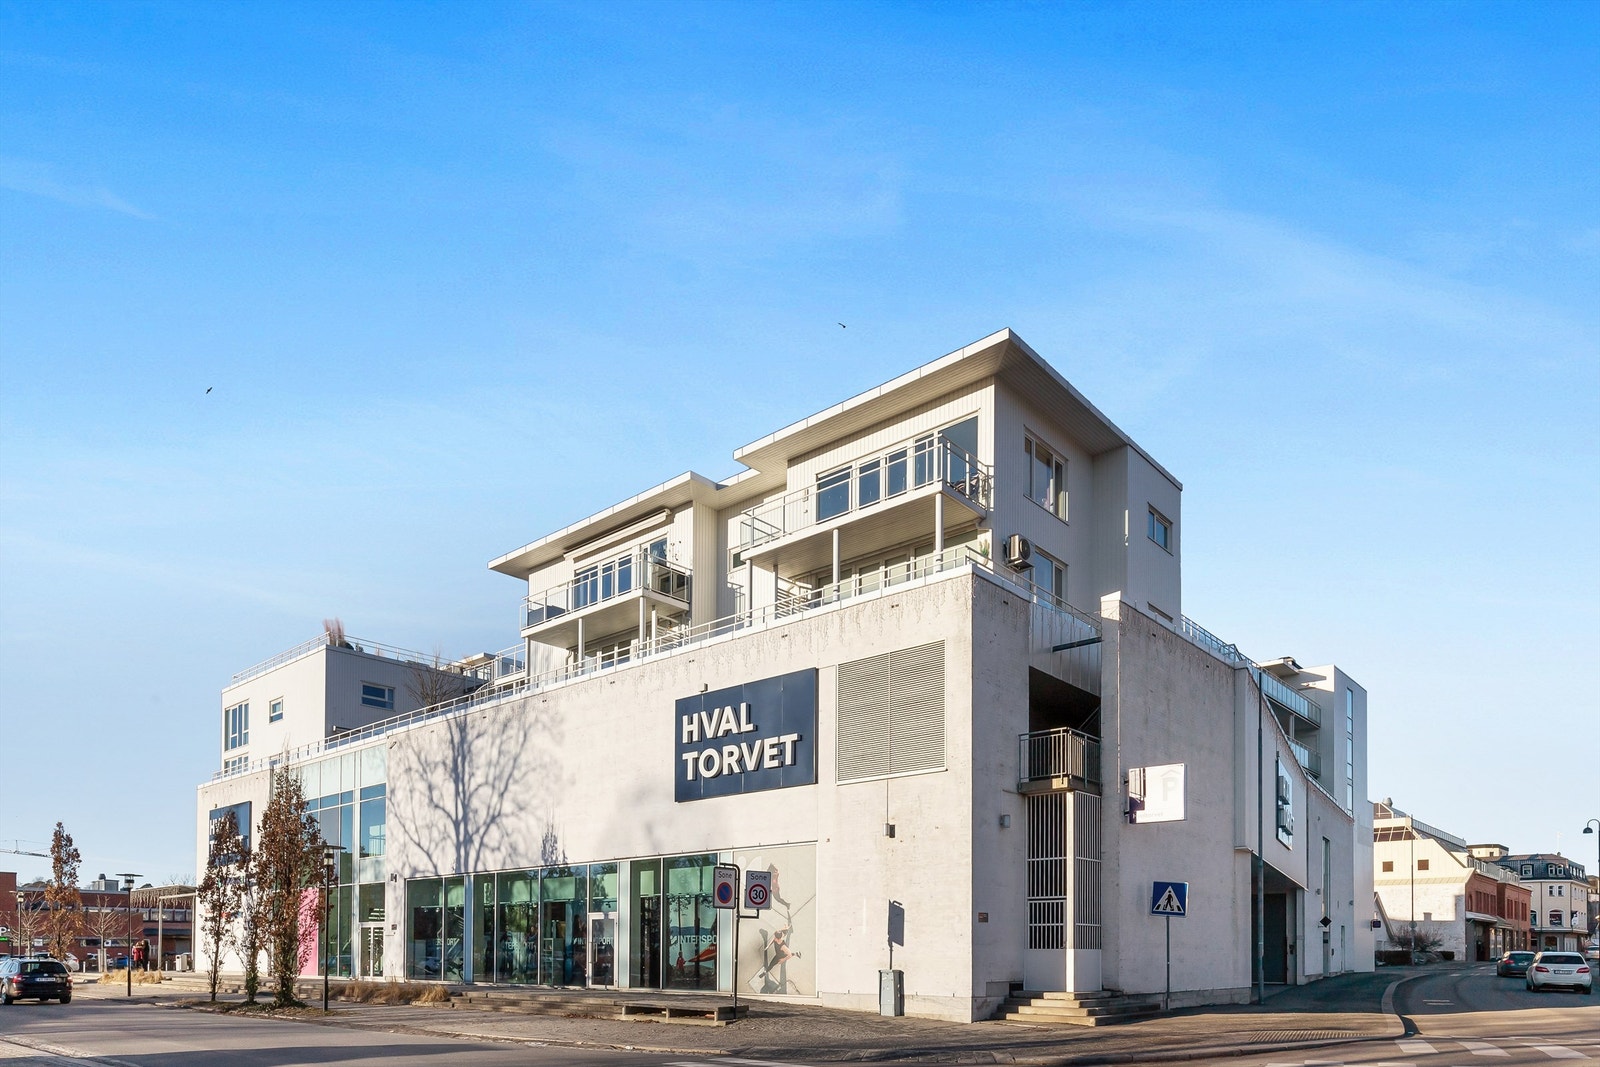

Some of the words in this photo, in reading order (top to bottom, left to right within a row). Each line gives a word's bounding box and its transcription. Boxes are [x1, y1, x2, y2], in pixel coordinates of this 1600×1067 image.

[682, 702, 755, 744] HVAL
[682, 733, 799, 781] TORVET
[718, 870, 733, 879] Sone
[750, 873, 767, 881] Sone
[752, 889, 765, 900] 30
